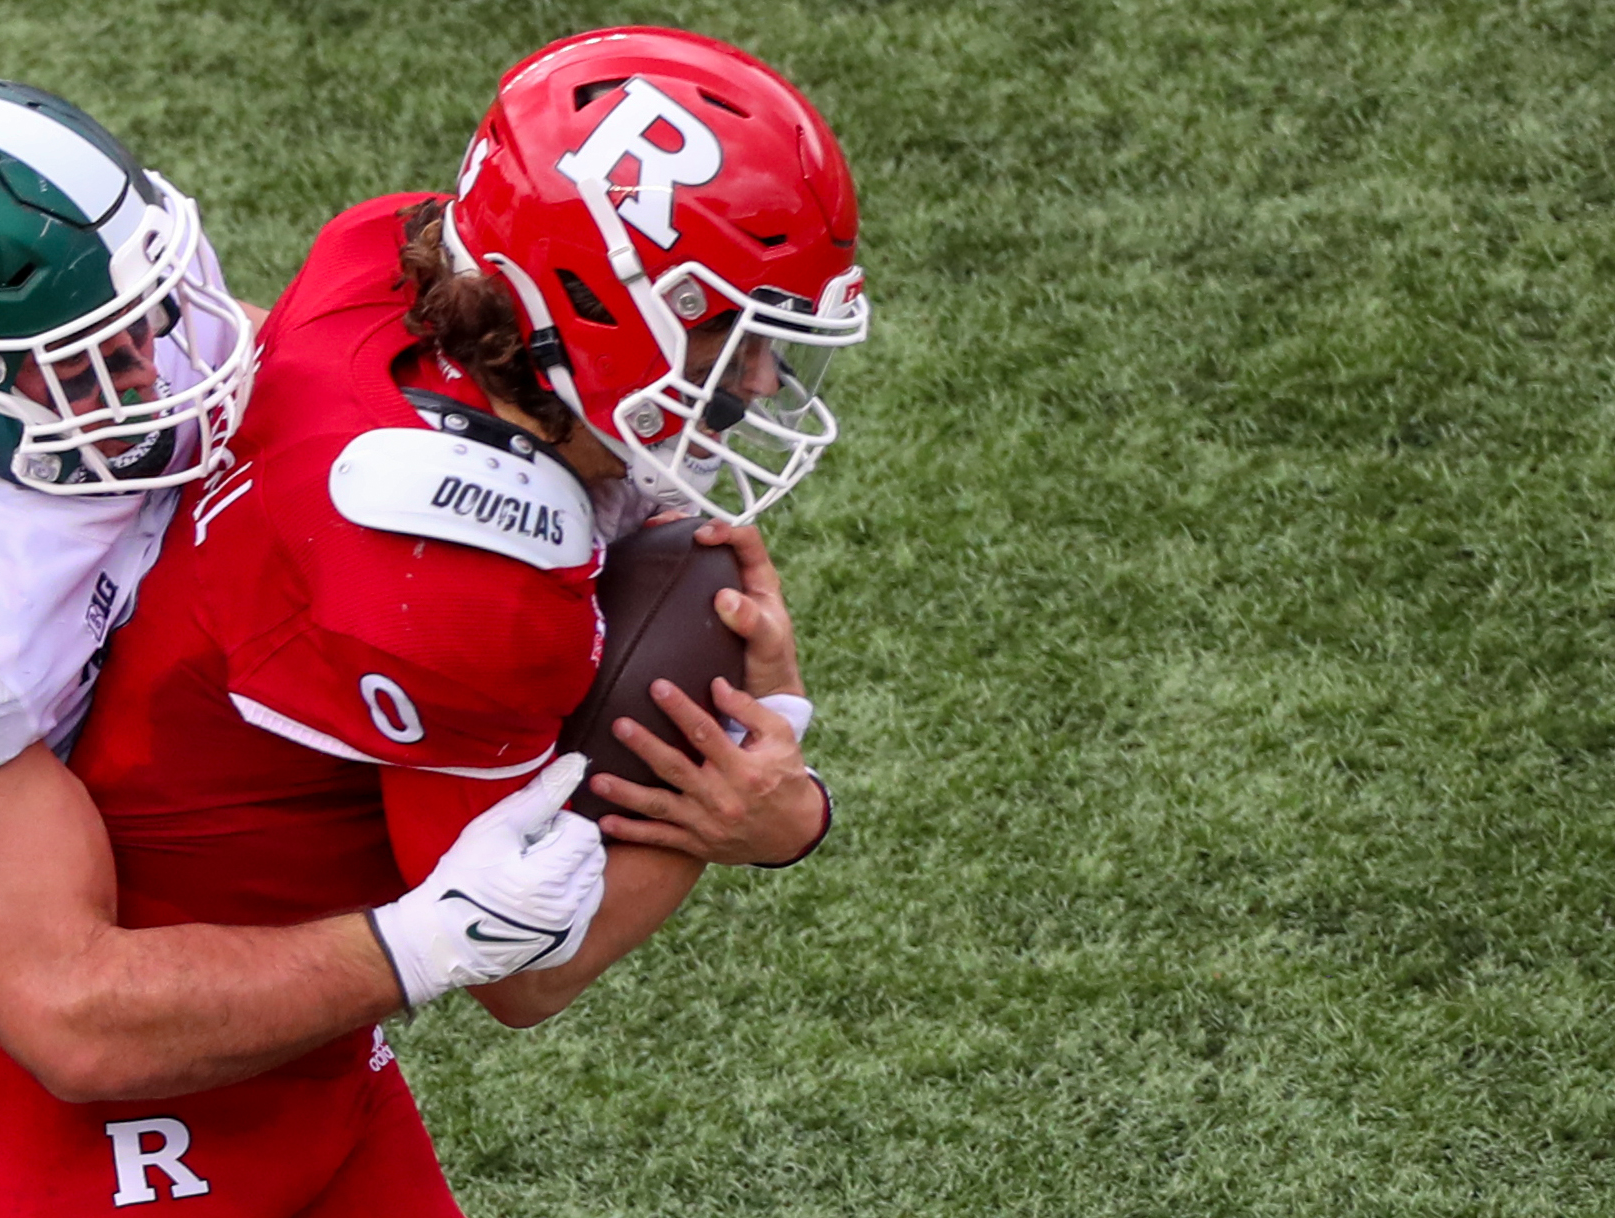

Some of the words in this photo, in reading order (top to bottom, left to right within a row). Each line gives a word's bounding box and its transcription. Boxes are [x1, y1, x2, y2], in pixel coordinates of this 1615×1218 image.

[557, 76, 723, 250] R
[431, 475, 566, 546] DOUGLAS
[359, 672, 425, 745] 0
[105, 1115, 210, 1208] R
